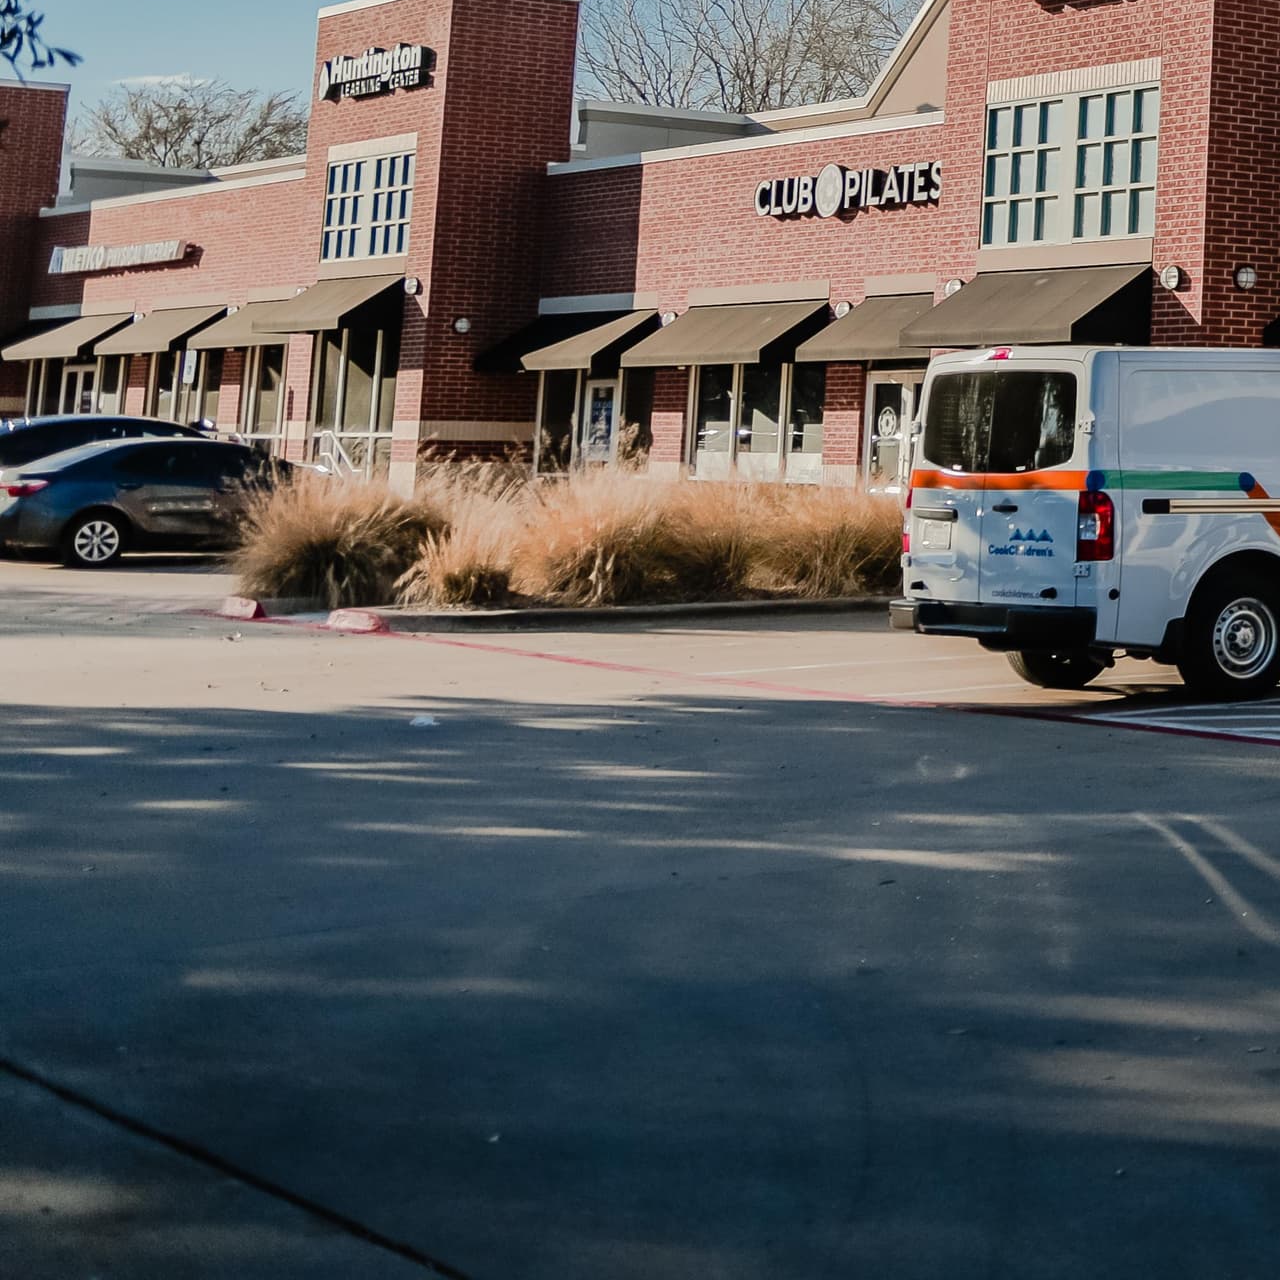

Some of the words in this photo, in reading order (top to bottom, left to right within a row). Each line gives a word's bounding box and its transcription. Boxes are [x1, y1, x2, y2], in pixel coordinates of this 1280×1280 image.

[330, 42, 421, 84] Huntington
[341, 76, 380, 97] LEARNING
[389, 69, 419, 89] CENTER
[755, 176, 813, 216] CLUB
[844, 161, 942, 209] PILATES
[988, 544, 1053, 557] CookCdren's
